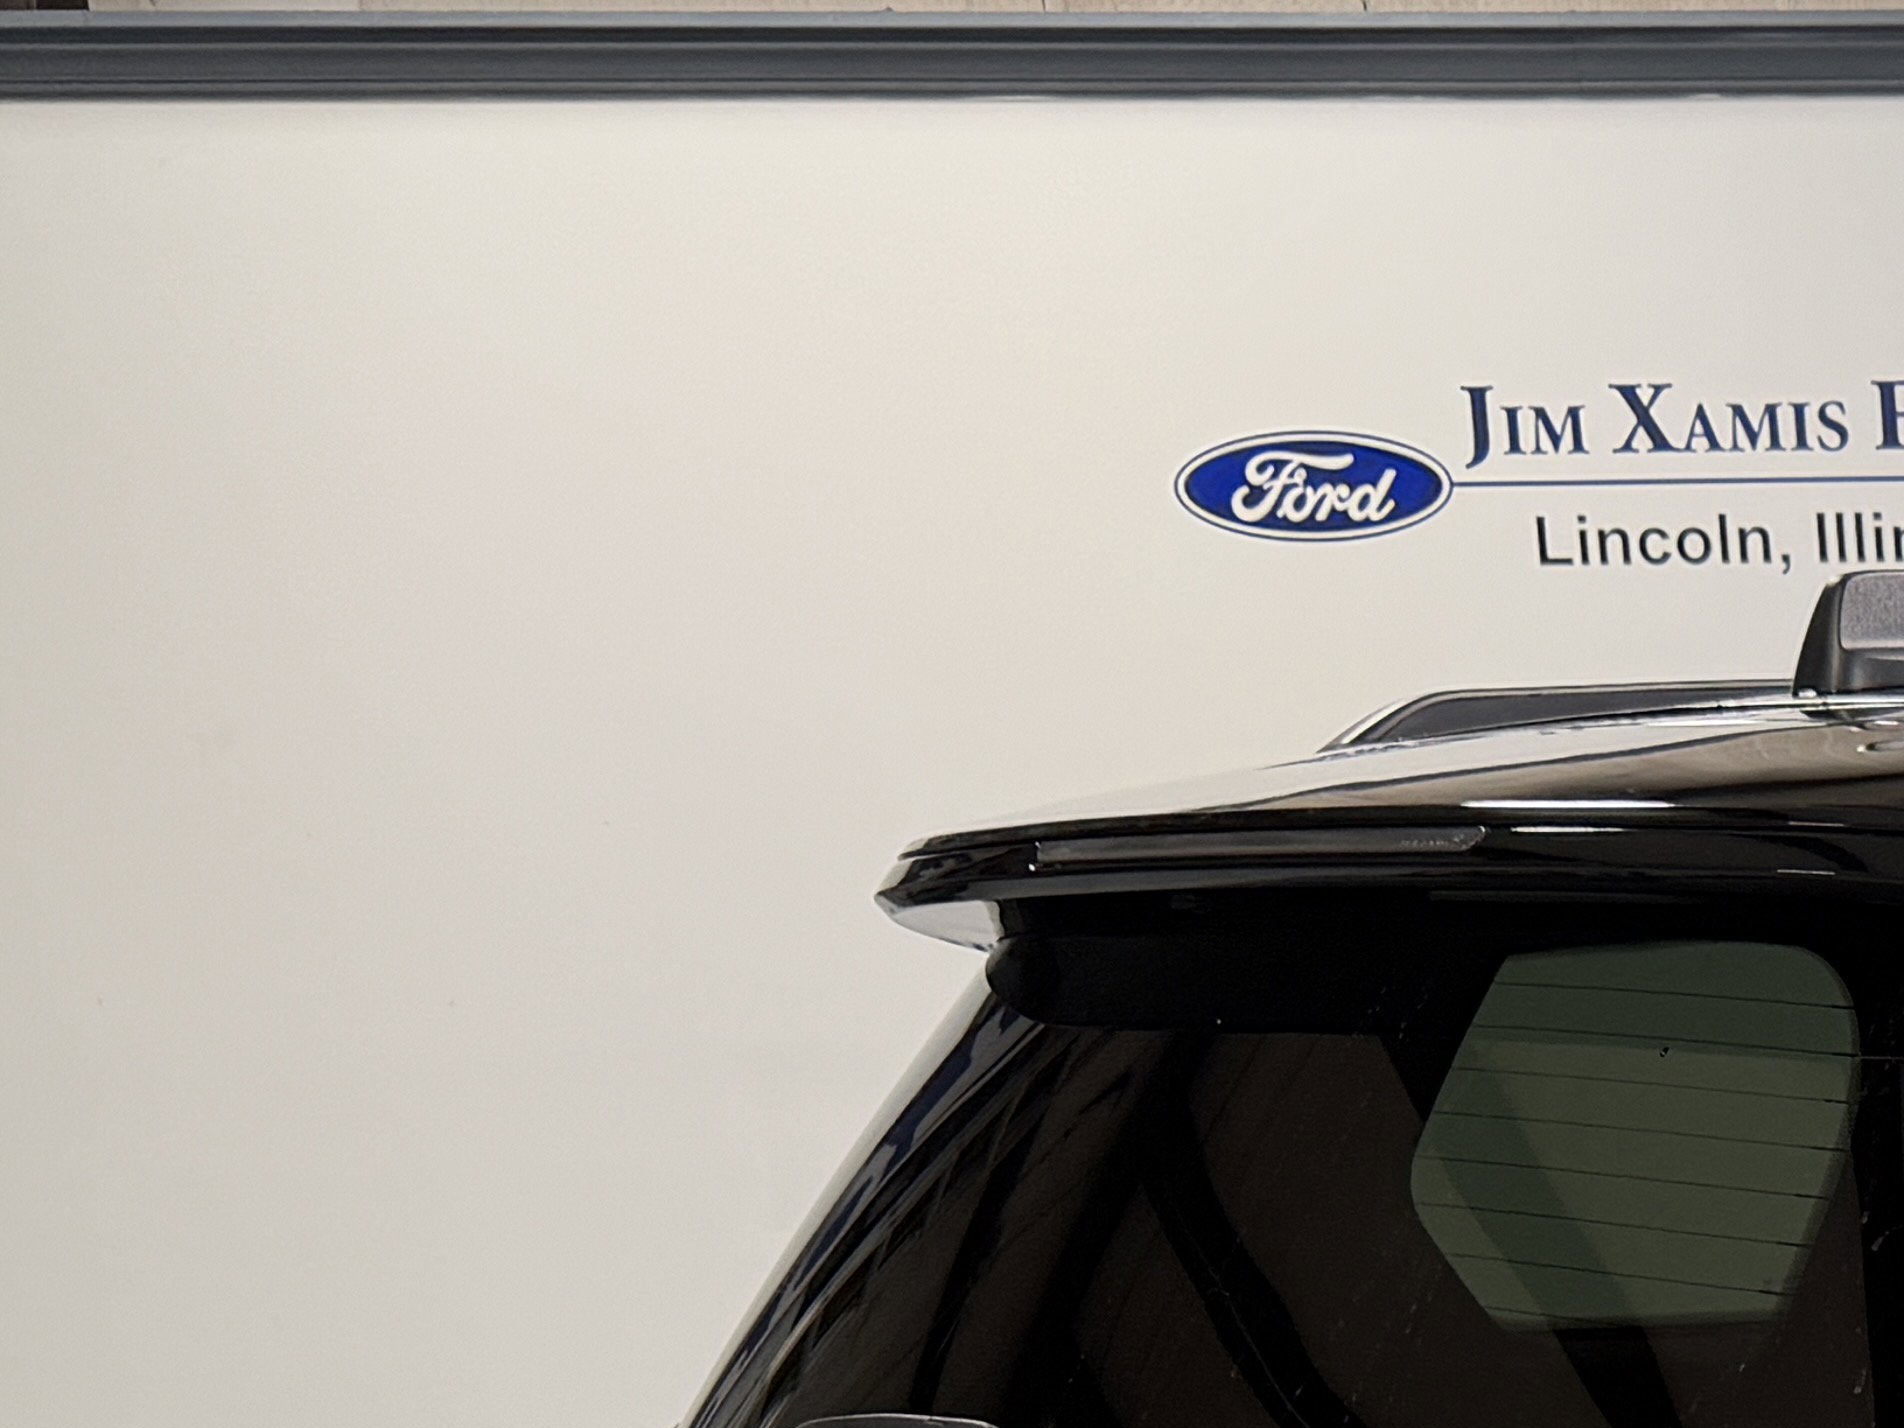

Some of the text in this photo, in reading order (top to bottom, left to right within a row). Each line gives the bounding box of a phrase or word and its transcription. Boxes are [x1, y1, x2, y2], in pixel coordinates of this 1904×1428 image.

[1460, 385, 1589, 470] JIM
[1608, 383, 1849, 454] XAMIS
[1230, 450, 1397, 523] Ford
[1536, 513, 1791, 575] Lincoln,
